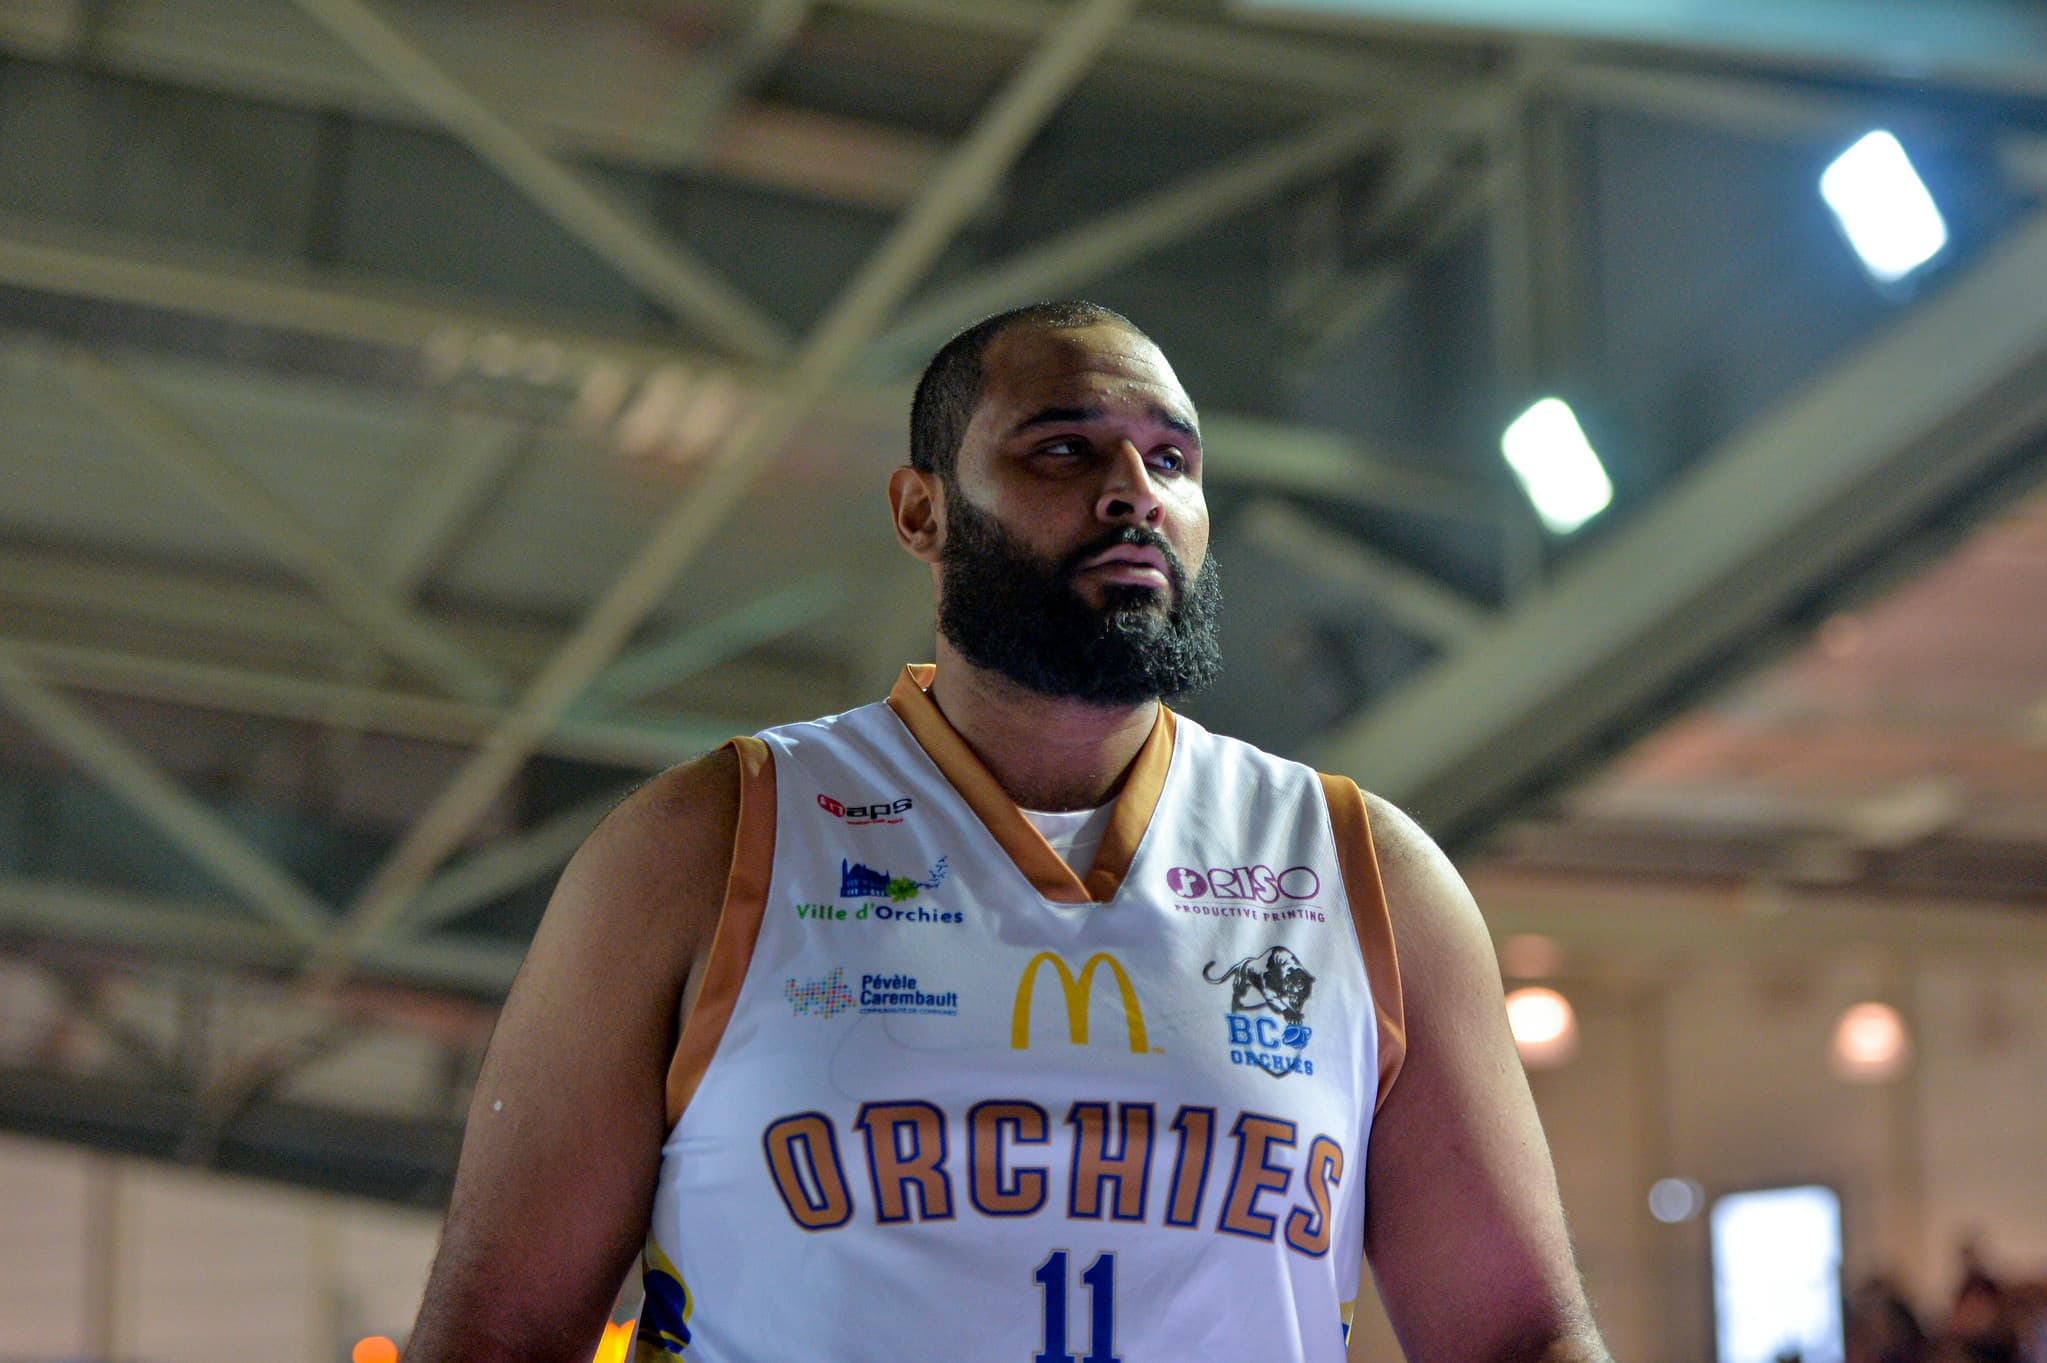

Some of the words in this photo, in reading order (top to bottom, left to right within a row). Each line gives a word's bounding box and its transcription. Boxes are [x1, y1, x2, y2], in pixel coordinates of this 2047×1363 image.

[1207, 864, 1320, 904] RISO
[796, 903, 847, 921] Ville
[855, 903, 964, 924] d'Orchies
[1173, 903, 1258, 921] PRODUCTIVE
[1263, 908, 1326, 924] PRINTING
[861, 973, 917, 990] Pévèle
[860, 990, 958, 1007] Carembault
[1230, 1049, 1314, 1076] ORCHIES
[762, 1098, 1344, 1260] ORCHIES
[1032, 1248, 1125, 1363] 11
